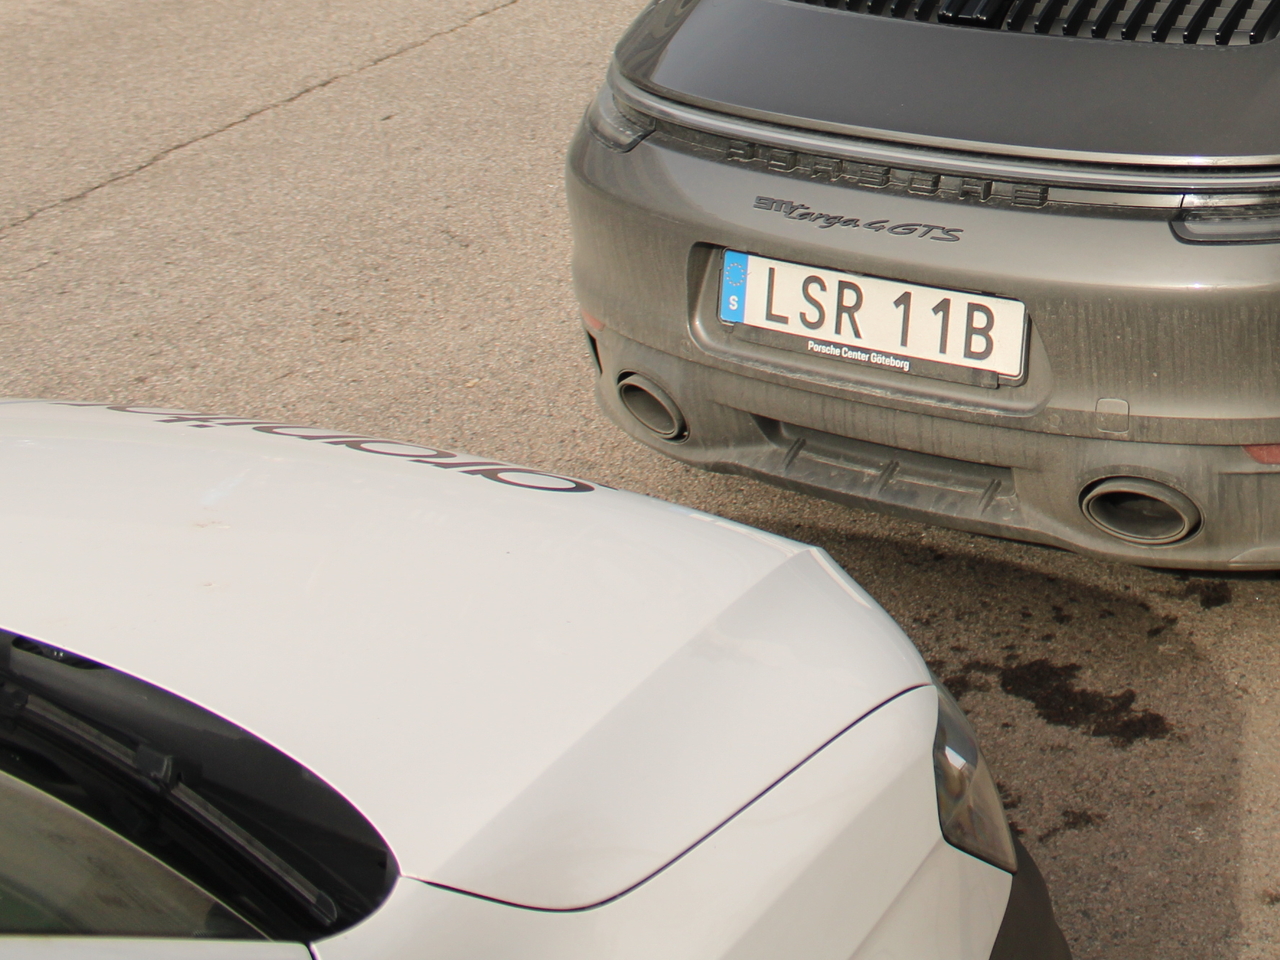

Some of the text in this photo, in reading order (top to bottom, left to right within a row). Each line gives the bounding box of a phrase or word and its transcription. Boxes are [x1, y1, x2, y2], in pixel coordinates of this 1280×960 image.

[726, 140, 1049, 209] PORSCHE
[887, 222, 964, 242] GTS
[728, 295, 739, 311] S
[765, 266, 996, 361] LSR 11B
[807, 340, 910, 372] Porsche Center Göteborg
